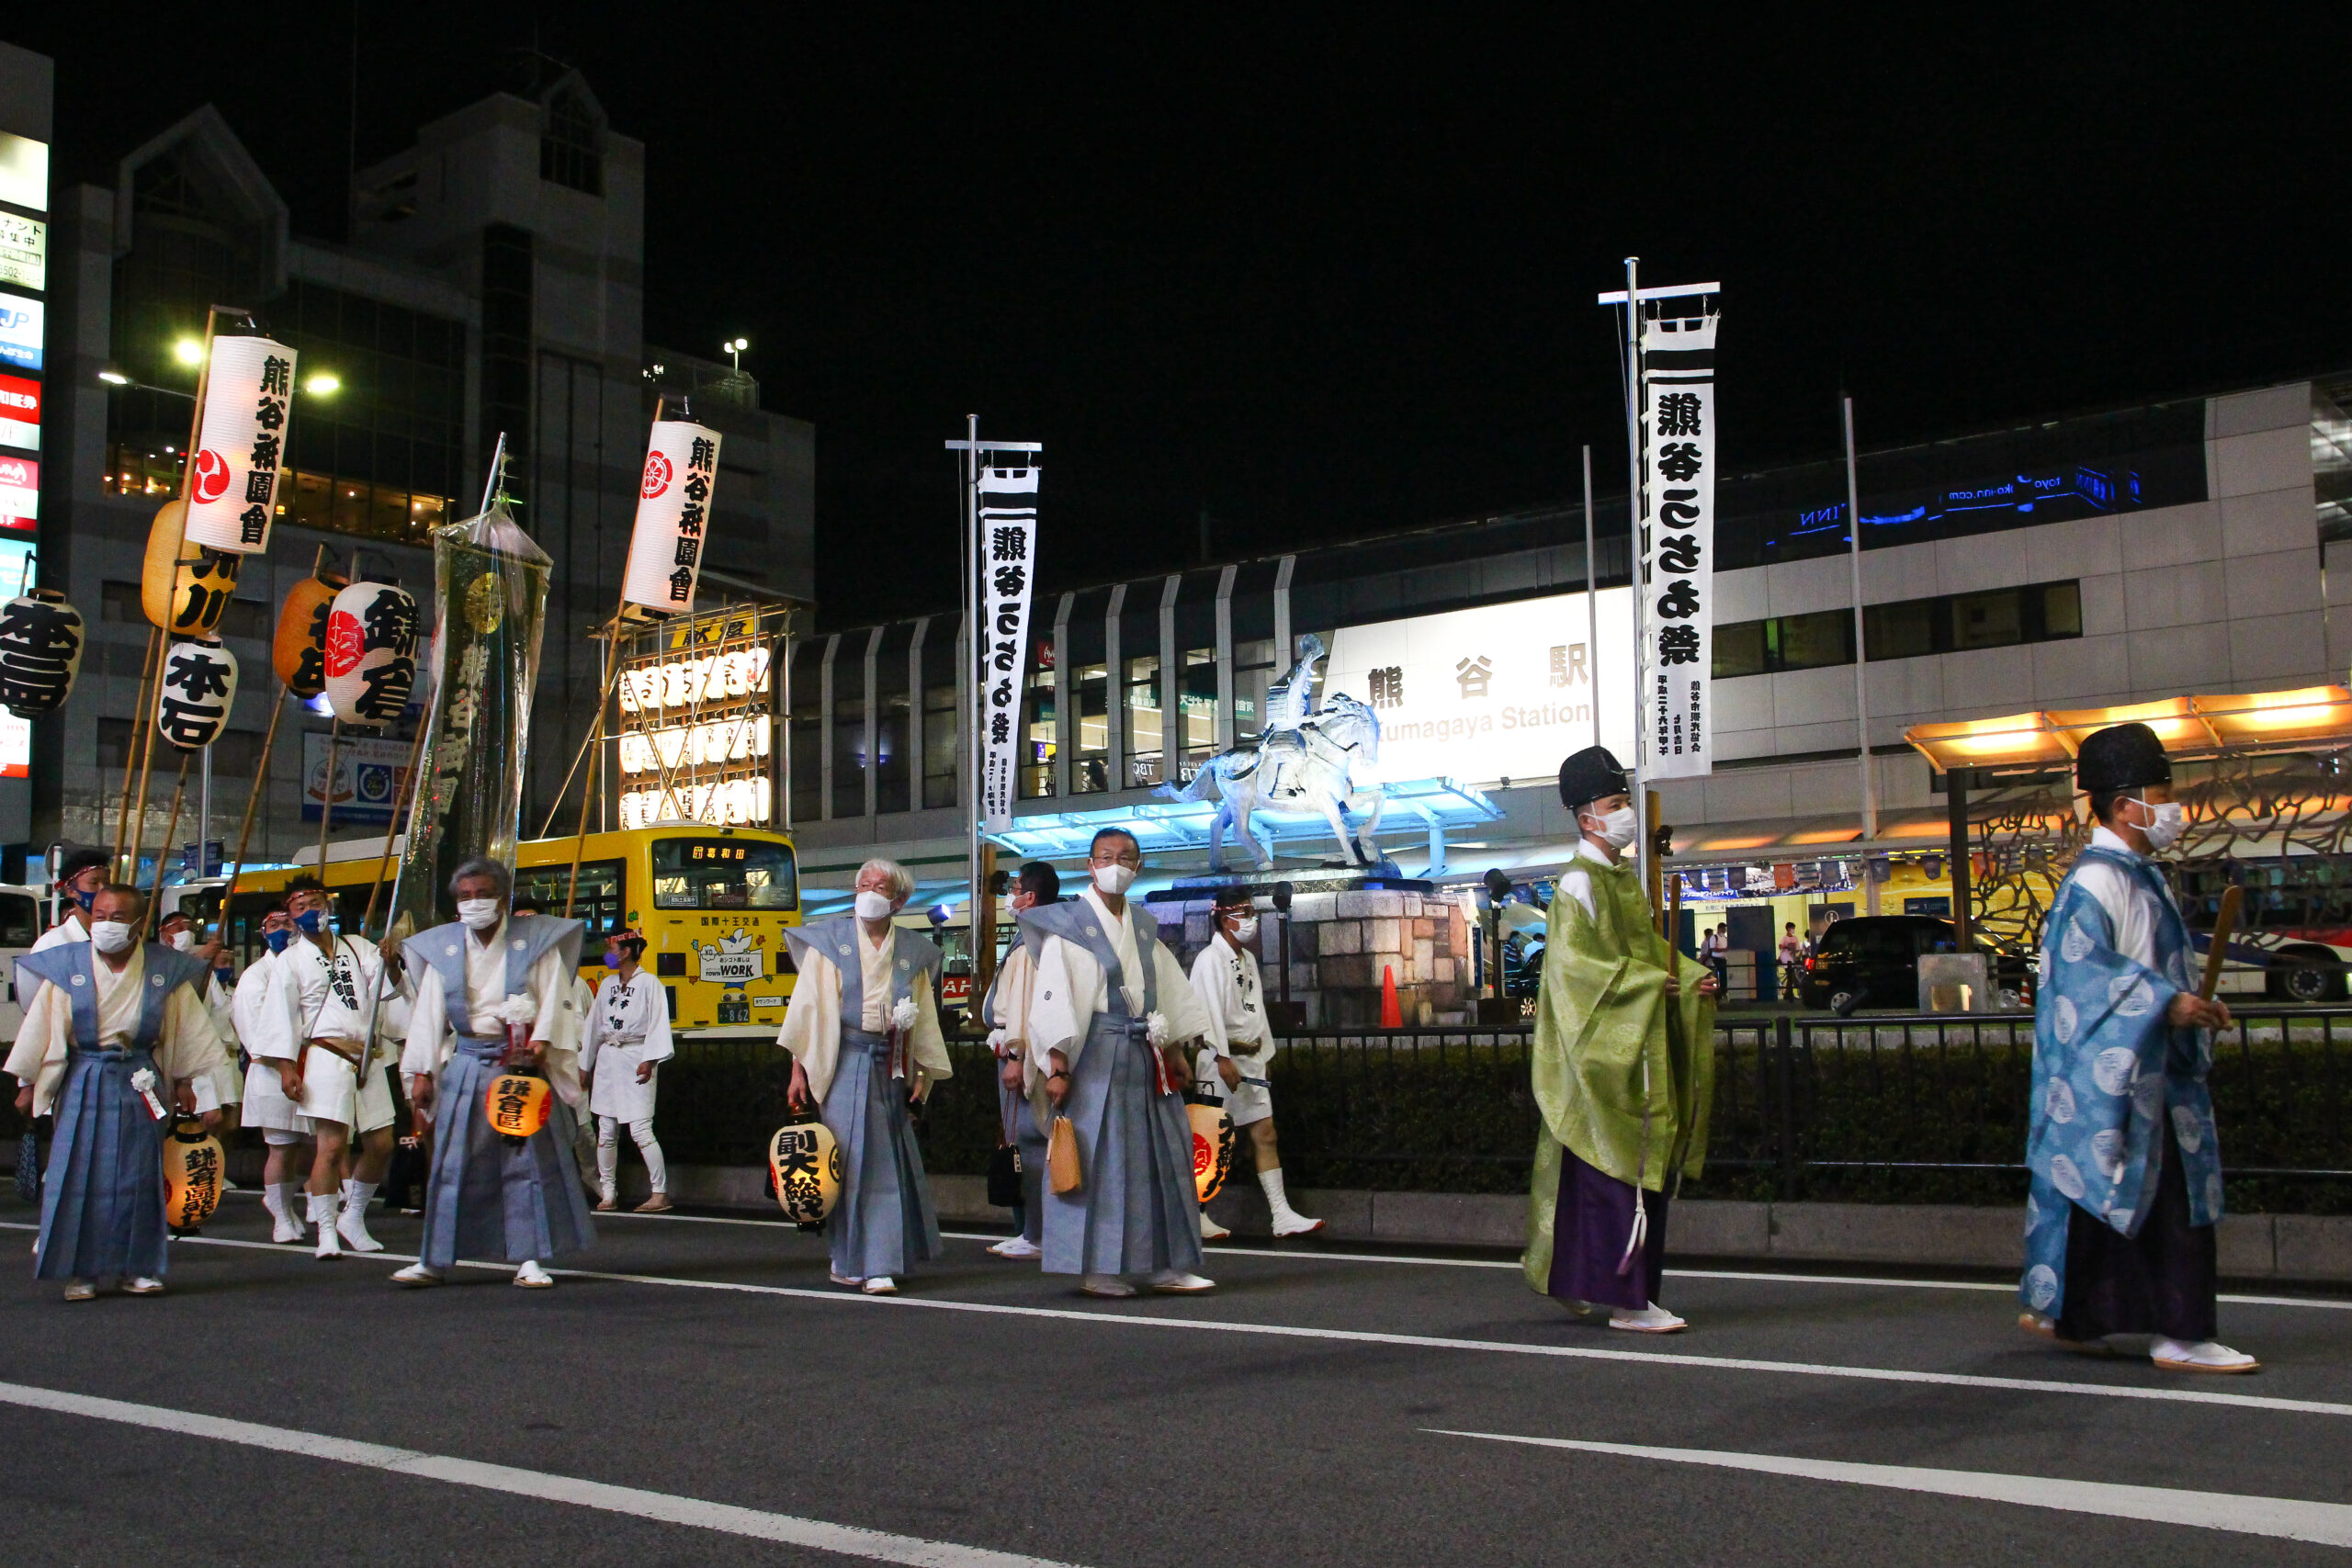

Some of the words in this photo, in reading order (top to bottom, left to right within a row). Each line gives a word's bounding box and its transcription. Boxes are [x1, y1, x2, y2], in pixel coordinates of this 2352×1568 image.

[1368, 643, 1589, 710] 熊谷駅
[161, 654, 232, 745] 本石
[1501, 702, 1590, 730] Station
[707, 847, 745, 860] 葛和田
[701, 917, 760, 926] 国際十王交通
[720, 965, 754, 977] WORK
